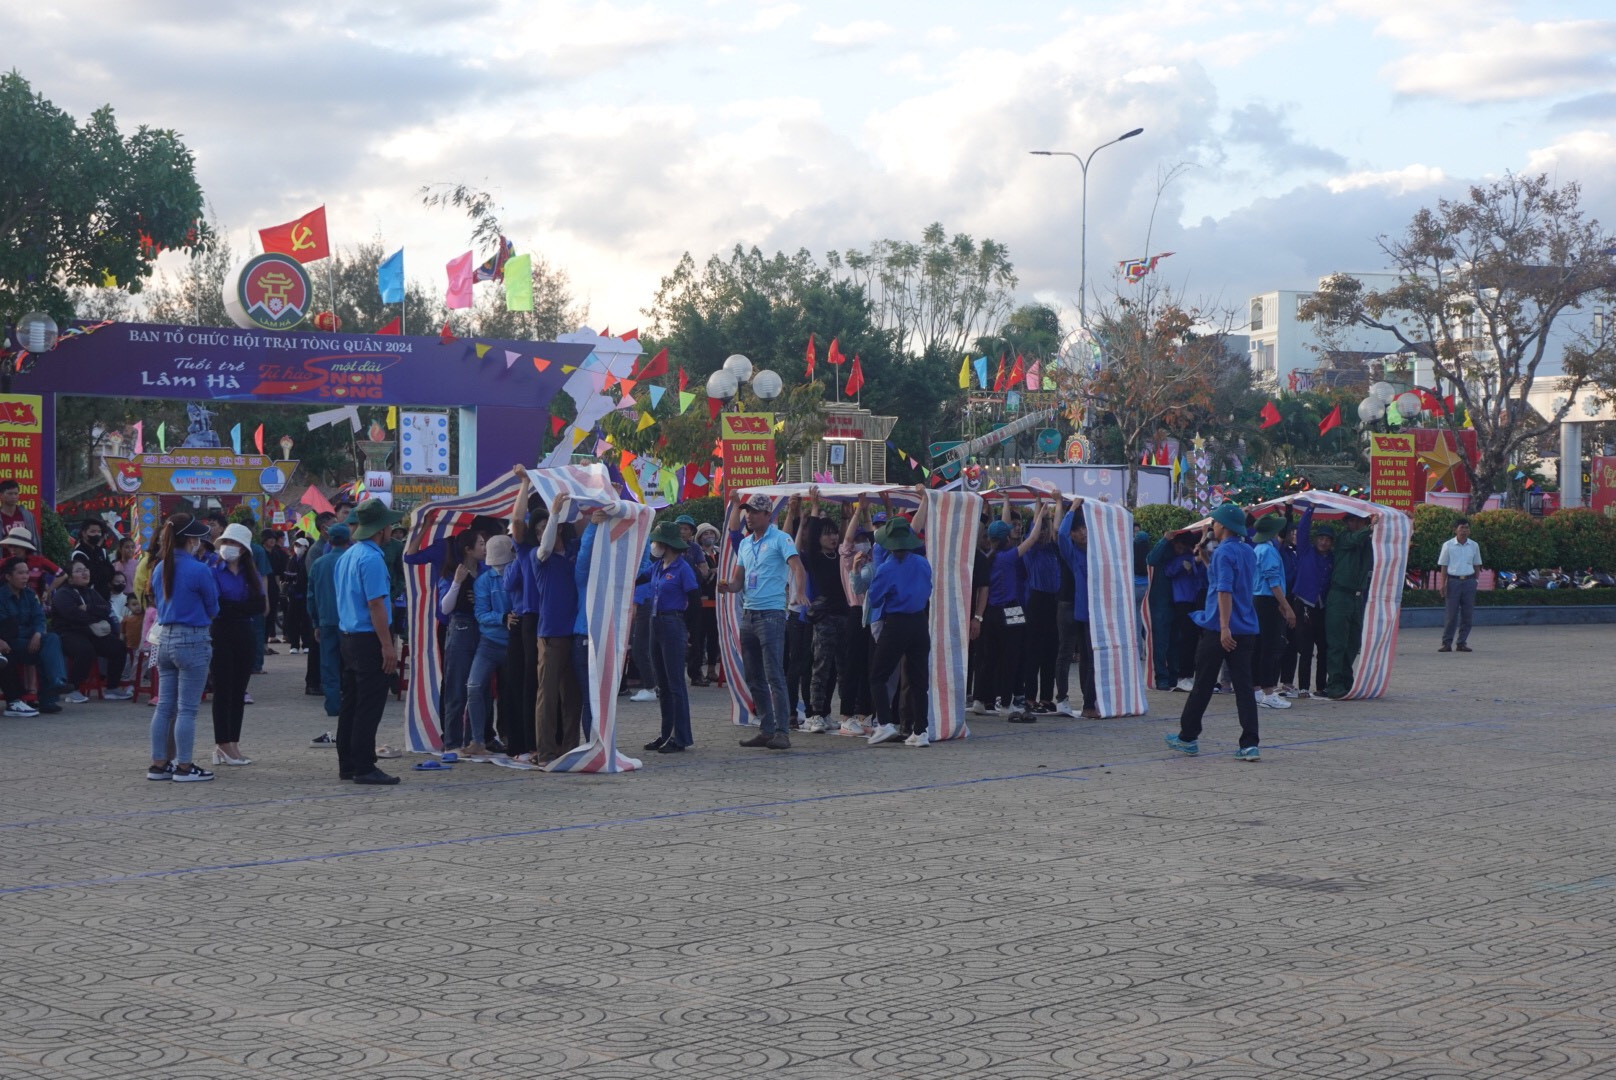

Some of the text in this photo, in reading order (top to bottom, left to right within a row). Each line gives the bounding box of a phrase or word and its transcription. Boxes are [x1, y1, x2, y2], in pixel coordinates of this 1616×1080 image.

[129, 327, 412, 353] BAN TỔ CHỨC HỘI TRẠI TÒNG QUÂN 2024
[174, 357, 245, 371] Tuổi trẻ
[330, 360, 357, 373] một
[141, 371, 240, 389] Lâm Hà
[330, 373, 383, 385] NON
[12, 435, 31, 447] TRẺ
[731, 441, 767, 451] TUỔI TRẺ
[13, 452, 28, 463] HÀ
[734, 454, 765, 463] LÂM HÀ
[1396, 469, 1406, 477] HÀ
[727, 478, 743, 487] LÊN
